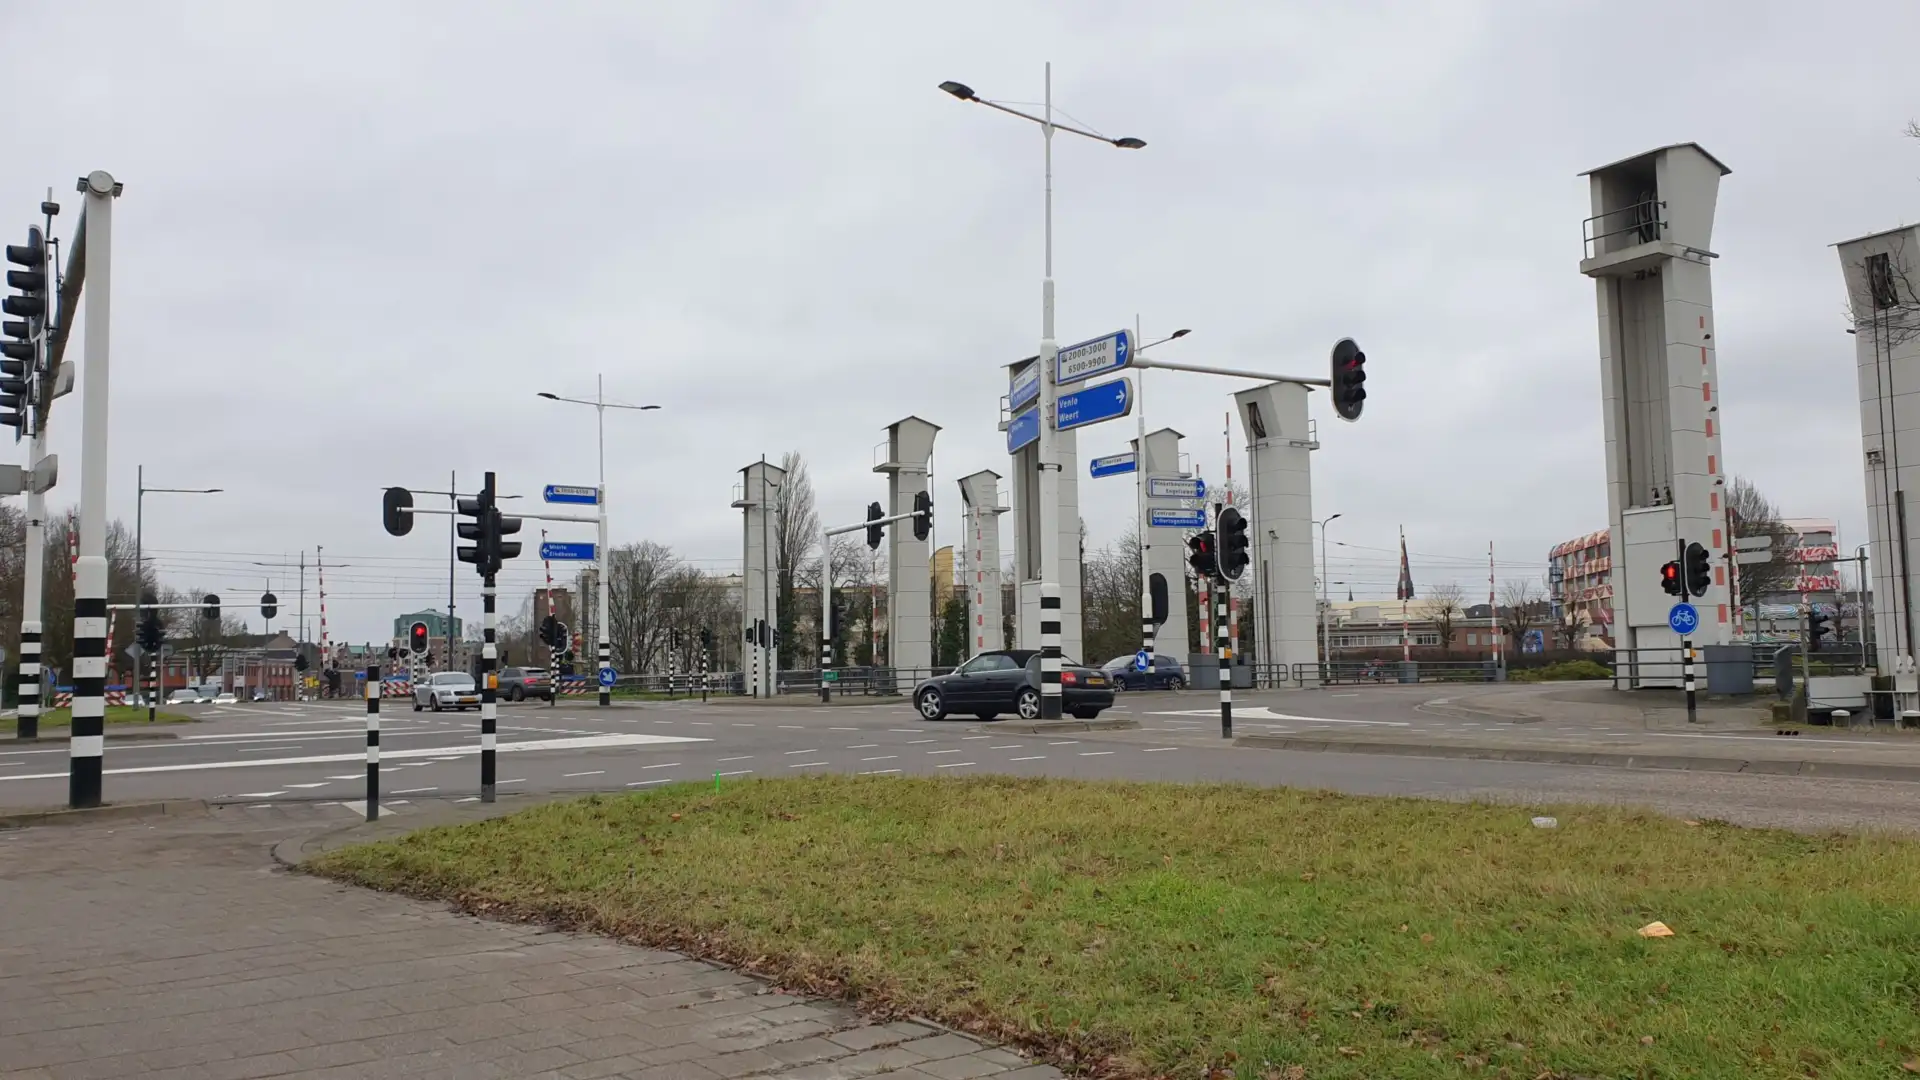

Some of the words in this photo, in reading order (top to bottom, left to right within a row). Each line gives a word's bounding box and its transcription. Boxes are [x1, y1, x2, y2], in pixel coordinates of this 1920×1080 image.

[1068, 341, 1107, 361] 2000-3000
[1068, 356, 1107, 374] 6500-9900
[1059, 397, 1078, 409] Venlo
[1059, 410, 1079, 422] Weert
